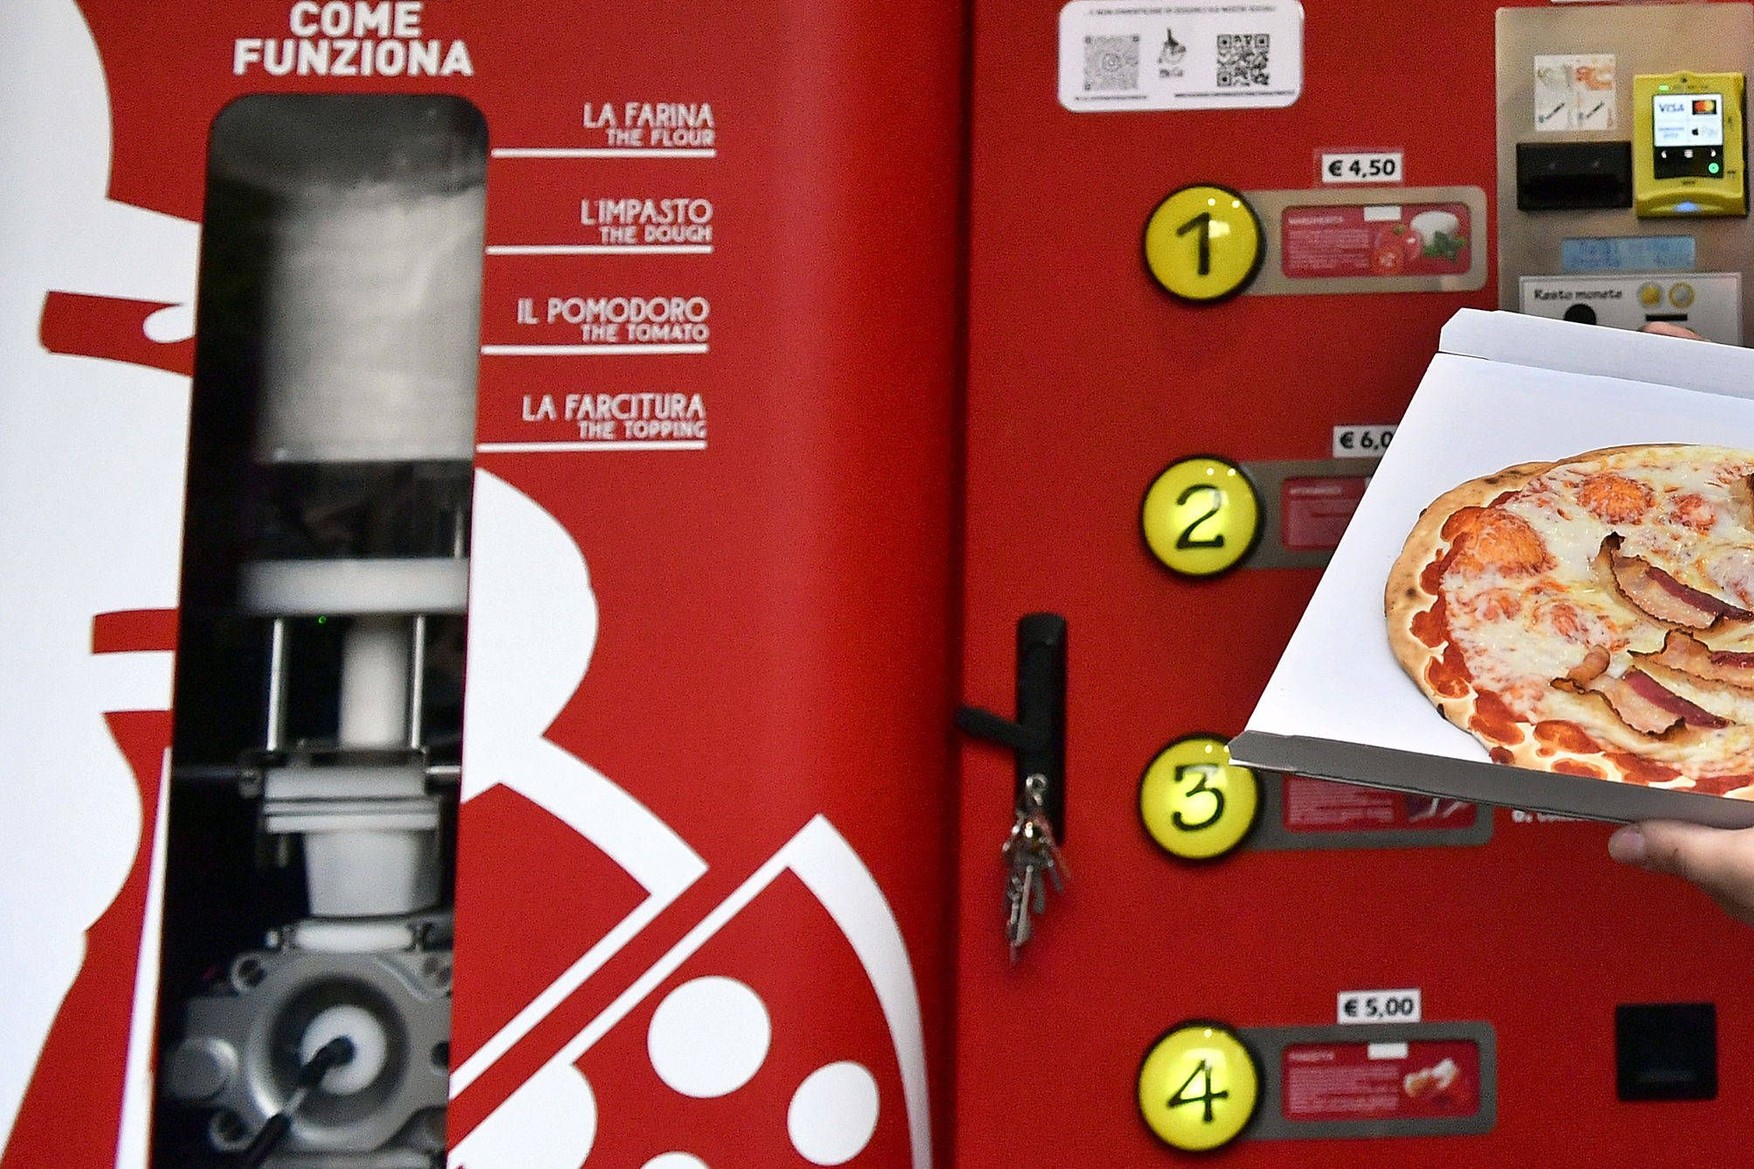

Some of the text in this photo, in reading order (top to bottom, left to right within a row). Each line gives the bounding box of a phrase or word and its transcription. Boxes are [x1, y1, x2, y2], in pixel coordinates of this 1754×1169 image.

[290, 1, 423, 37] COME
[233, 38, 474, 76] FUNZIONA
[583, 102, 714, 128] LA FARINA
[606, 128, 715, 147] THE FLOUR
[1328, 159, 1396, 179] € 4,50
[600, 225, 713, 244] THE DOUGH
[1176, 212, 1210, 276] 1
[517, 296, 711, 325] IL POMODORO
[582, 323, 710, 343] THE TOMATO
[522, 392, 706, 422] LA FARCITURA
[578, 420, 707, 439] THE TOPPING
[1340, 431, 1395, 450] € 6,0
[1175, 484, 1225, 550] 2
[1171, 763, 1225, 831] 3
[1344, 995, 1414, 1018] € 5,00
[1167, 1059, 1229, 1123] 4
